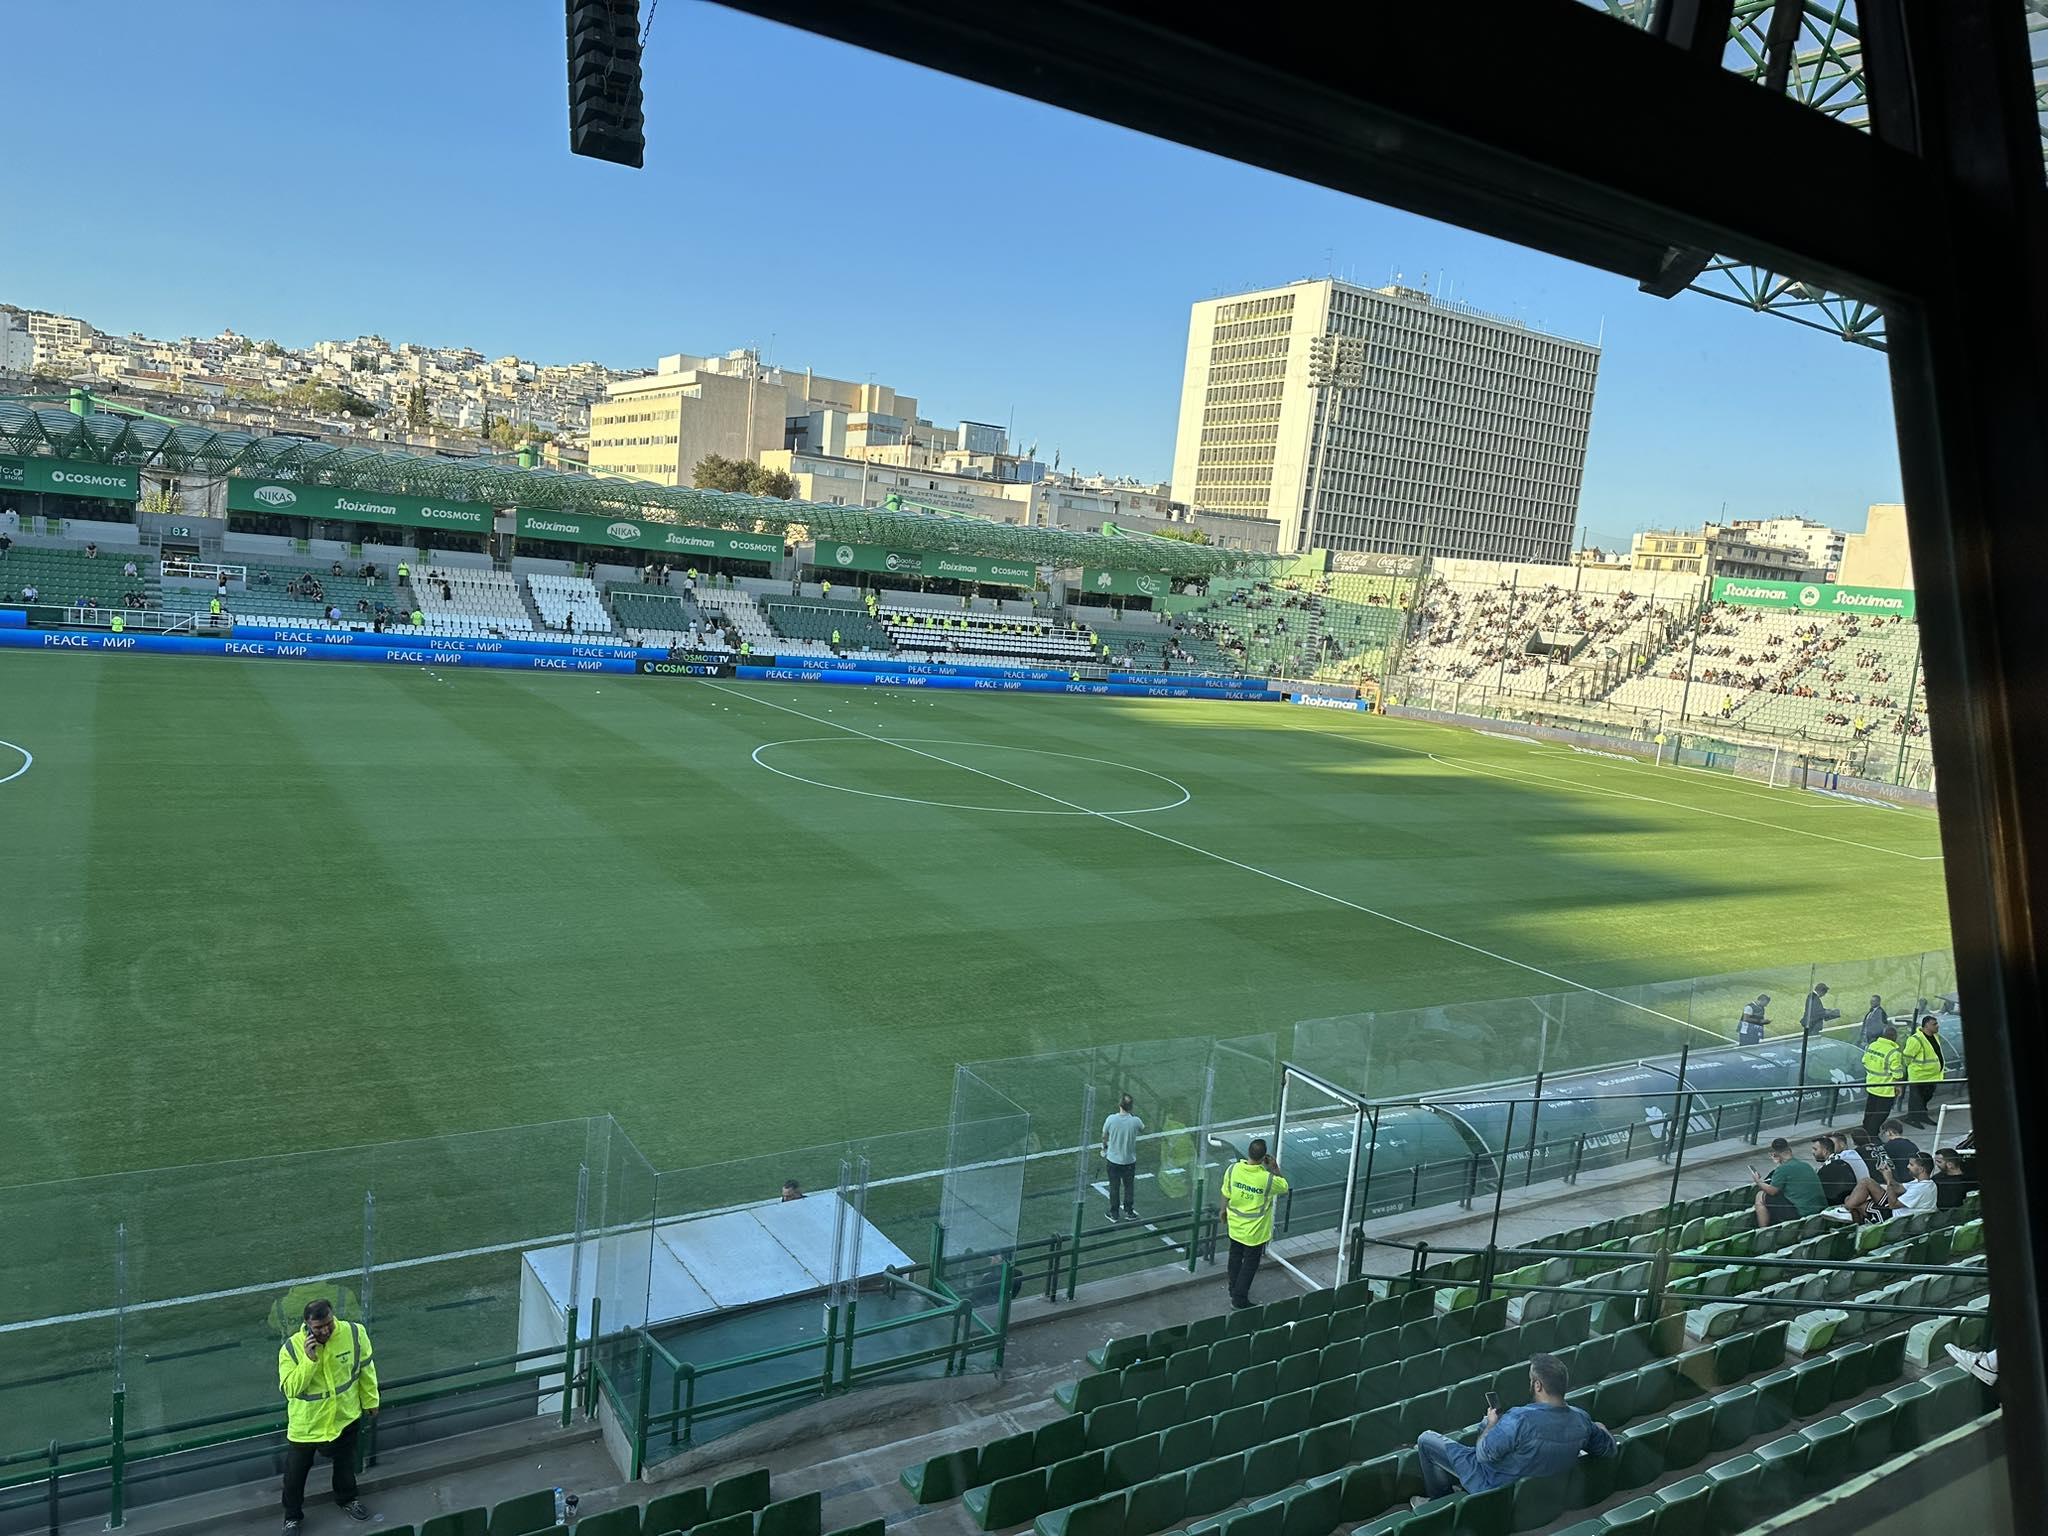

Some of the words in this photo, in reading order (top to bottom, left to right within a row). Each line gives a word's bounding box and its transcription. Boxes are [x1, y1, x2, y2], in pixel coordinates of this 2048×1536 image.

[65, 473, 127, 488] COSMOTE
[258, 490, 293, 503] NIKAS
[334, 498, 396, 515] Stoiximan
[432, 509, 481, 522] COSMOTE
[525, 517, 580, 534] Stoiximan
[610, 526, 639, 538] NIKAS
[665, 533, 715, 548] Stoiximan
[738, 542, 777, 553] COSMOTE
[938, 560, 977, 574] Stoiximan
[999, 567, 1029, 577] COSMOTE
[1722, 582, 1786, 600] Stoiximan
[1832, 590, 1903, 609] Stoiximan
[44, 634, 89, 646] PEACE
[103, 637, 135, 647] МИР
[275, 631, 313, 642] PEACE
[325, 634, 353, 644] МИР
[225, 643, 264, 654] PEACE
[277, 645, 307, 656] МИР
[430, 640, 465, 650] PEACE
[476, 642, 502, 651] МИР
[387, 650, 423, 661] PEACE
[434, 653, 461, 663] МИР
[572, 647, 604, 657] PEACE
[613, 650, 637, 659] МИР
[683, 654, 718, 662] OSMOTE
[534, 658, 567, 668] PEACE
[577, 661, 602, 670] МИР
[655, 664, 705, 674] COSMOTE
[705, 666, 719, 675] TV
[803, 660, 829, 669] PEACE
[908, 665, 932, 674] PEACE
[766, 670, 793, 679] PEACE
[875, 675, 900, 684] PEACE
[1004, 671, 1025, 679] PEACE
[1128, 676, 1148, 684] PEACE
[975, 680, 998, 688] PEACE
[1066, 684, 1086, 692] PEACE
[1298, 694, 1358, 710] Stoiximan
